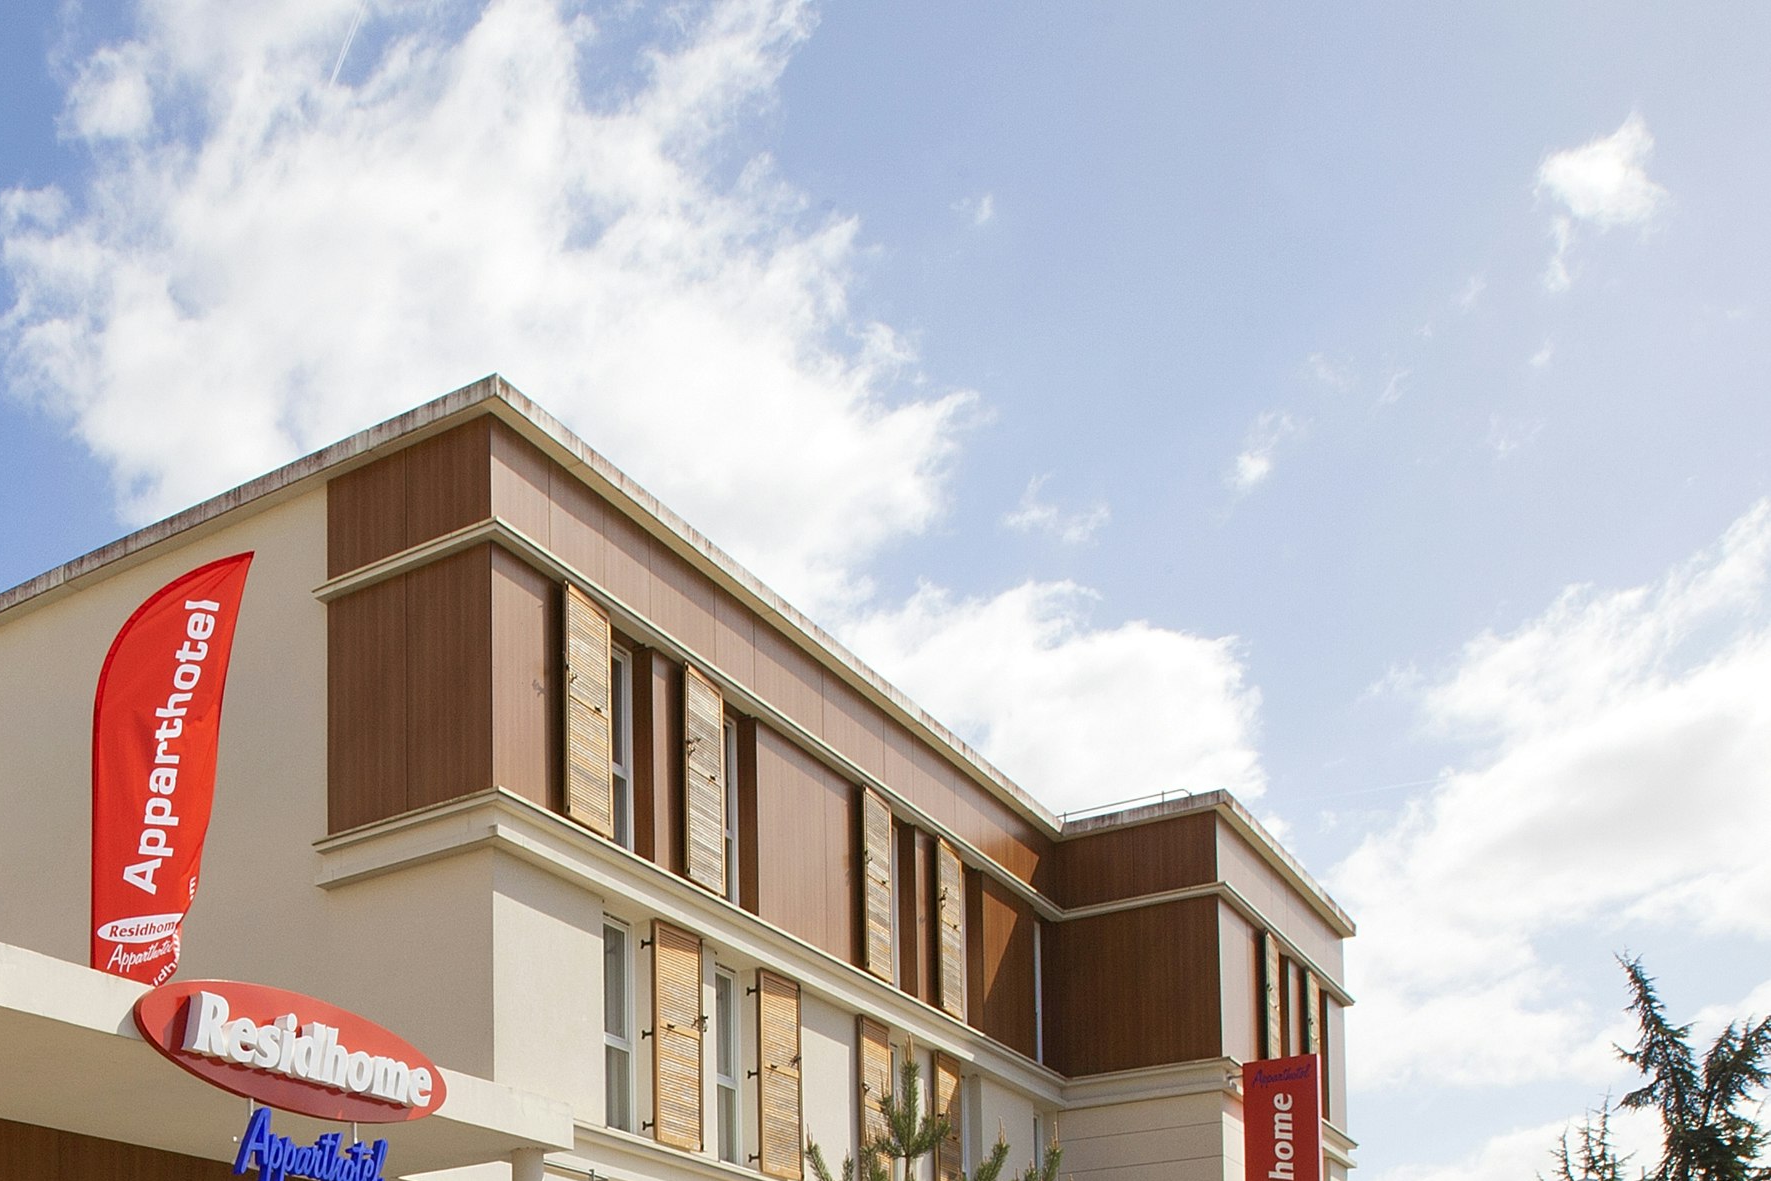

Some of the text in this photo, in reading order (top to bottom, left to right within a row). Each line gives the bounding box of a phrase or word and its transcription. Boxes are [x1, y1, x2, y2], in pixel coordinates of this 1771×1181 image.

[122, 599, 221, 895] Apparthotel
[109, 921, 175, 938] Residhom
[183, 990, 433, 1107] Residhome
